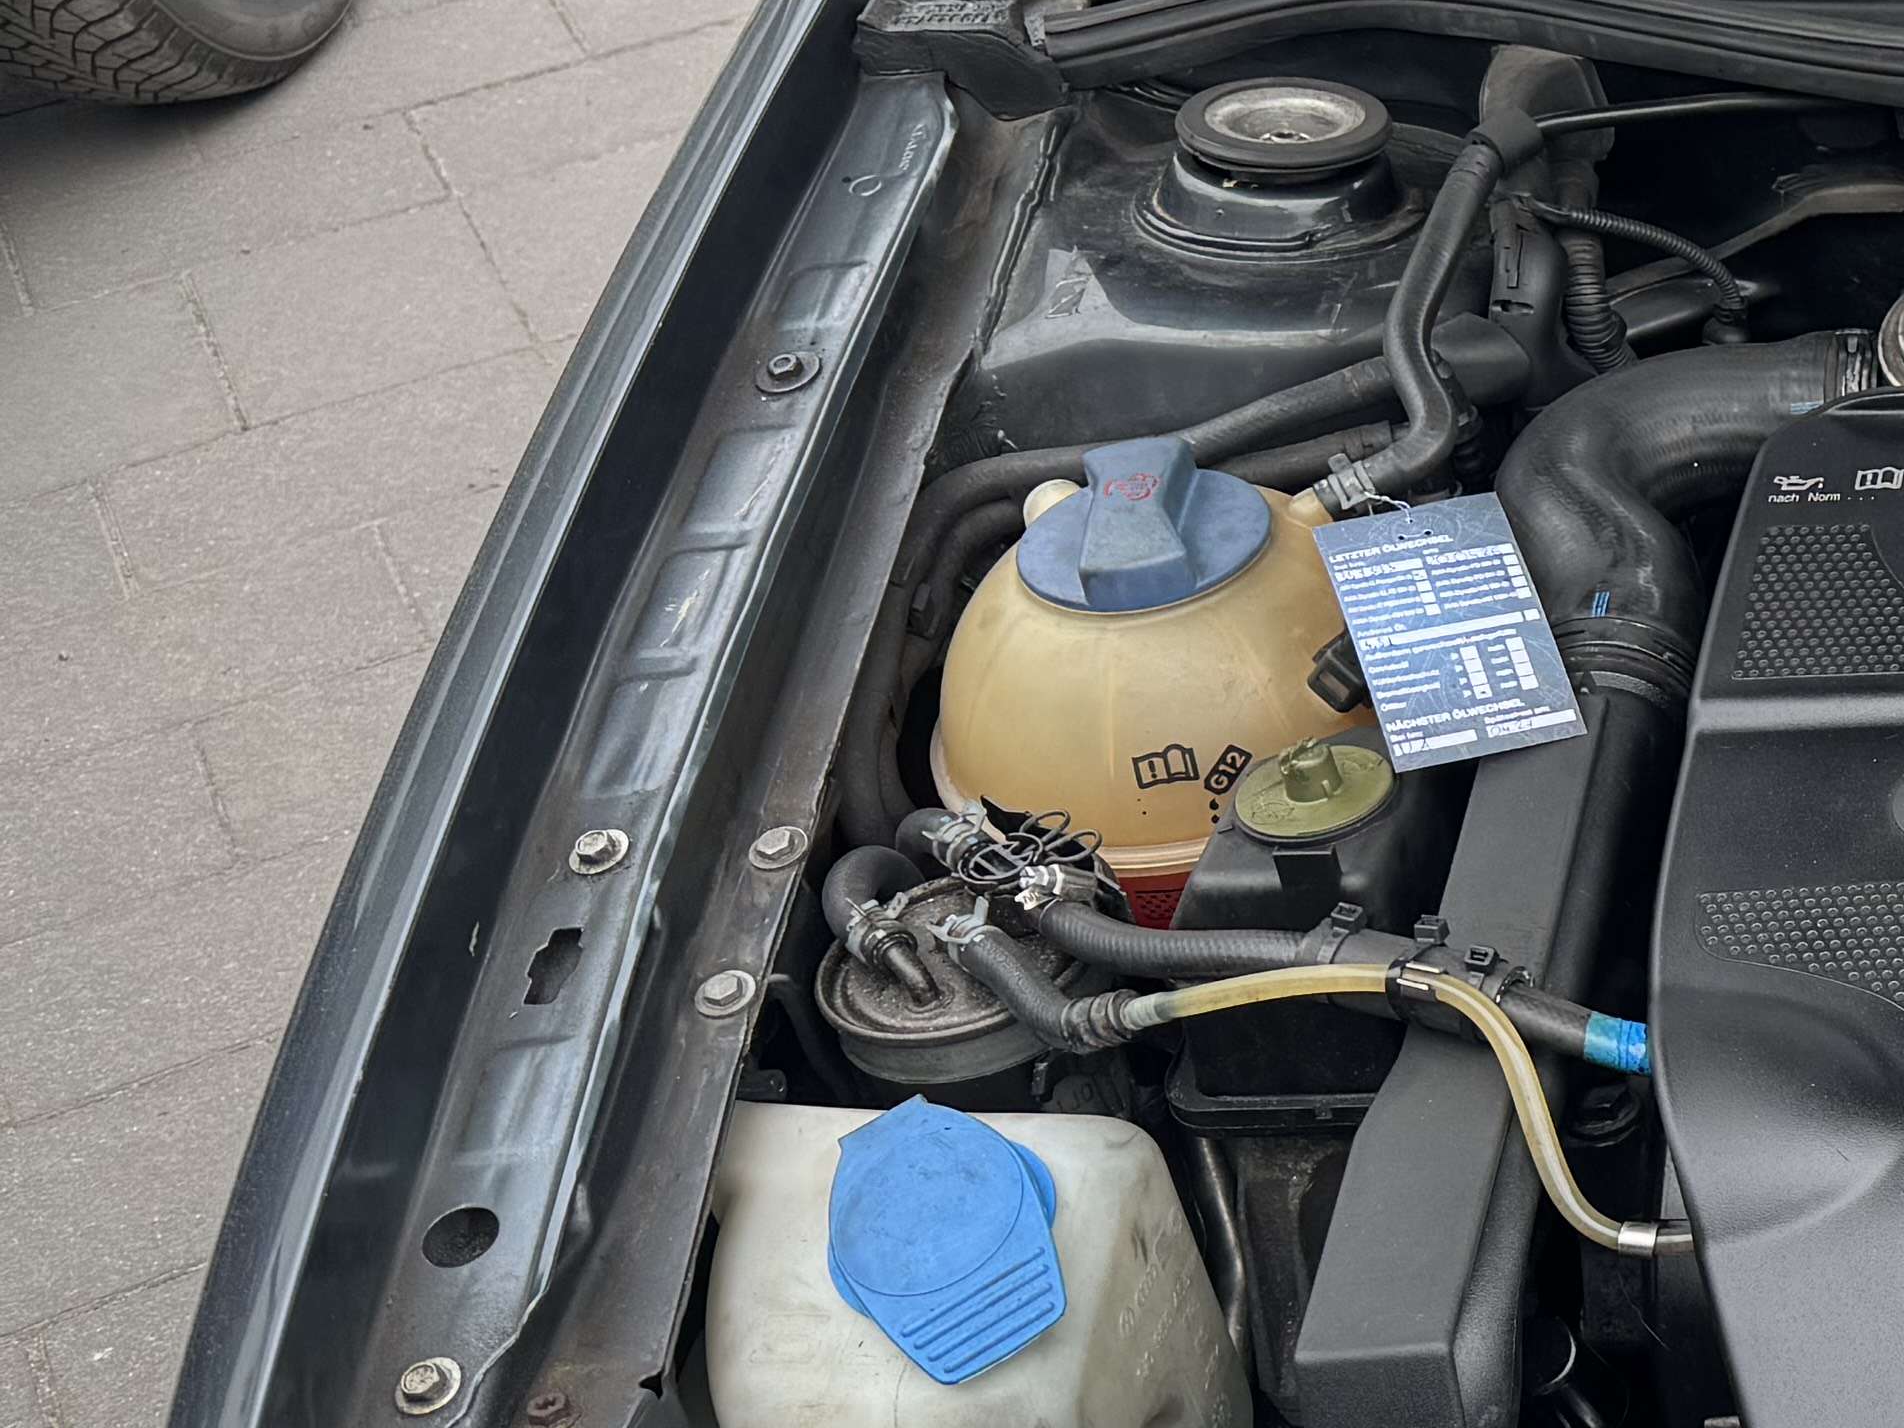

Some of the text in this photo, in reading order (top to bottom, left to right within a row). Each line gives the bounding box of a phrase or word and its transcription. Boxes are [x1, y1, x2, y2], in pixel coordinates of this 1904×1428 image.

[1768, 493, 1800, 503] nach
[1807, 491, 1841, 503] Norm
[1210, 753, 1246, 790] G12
